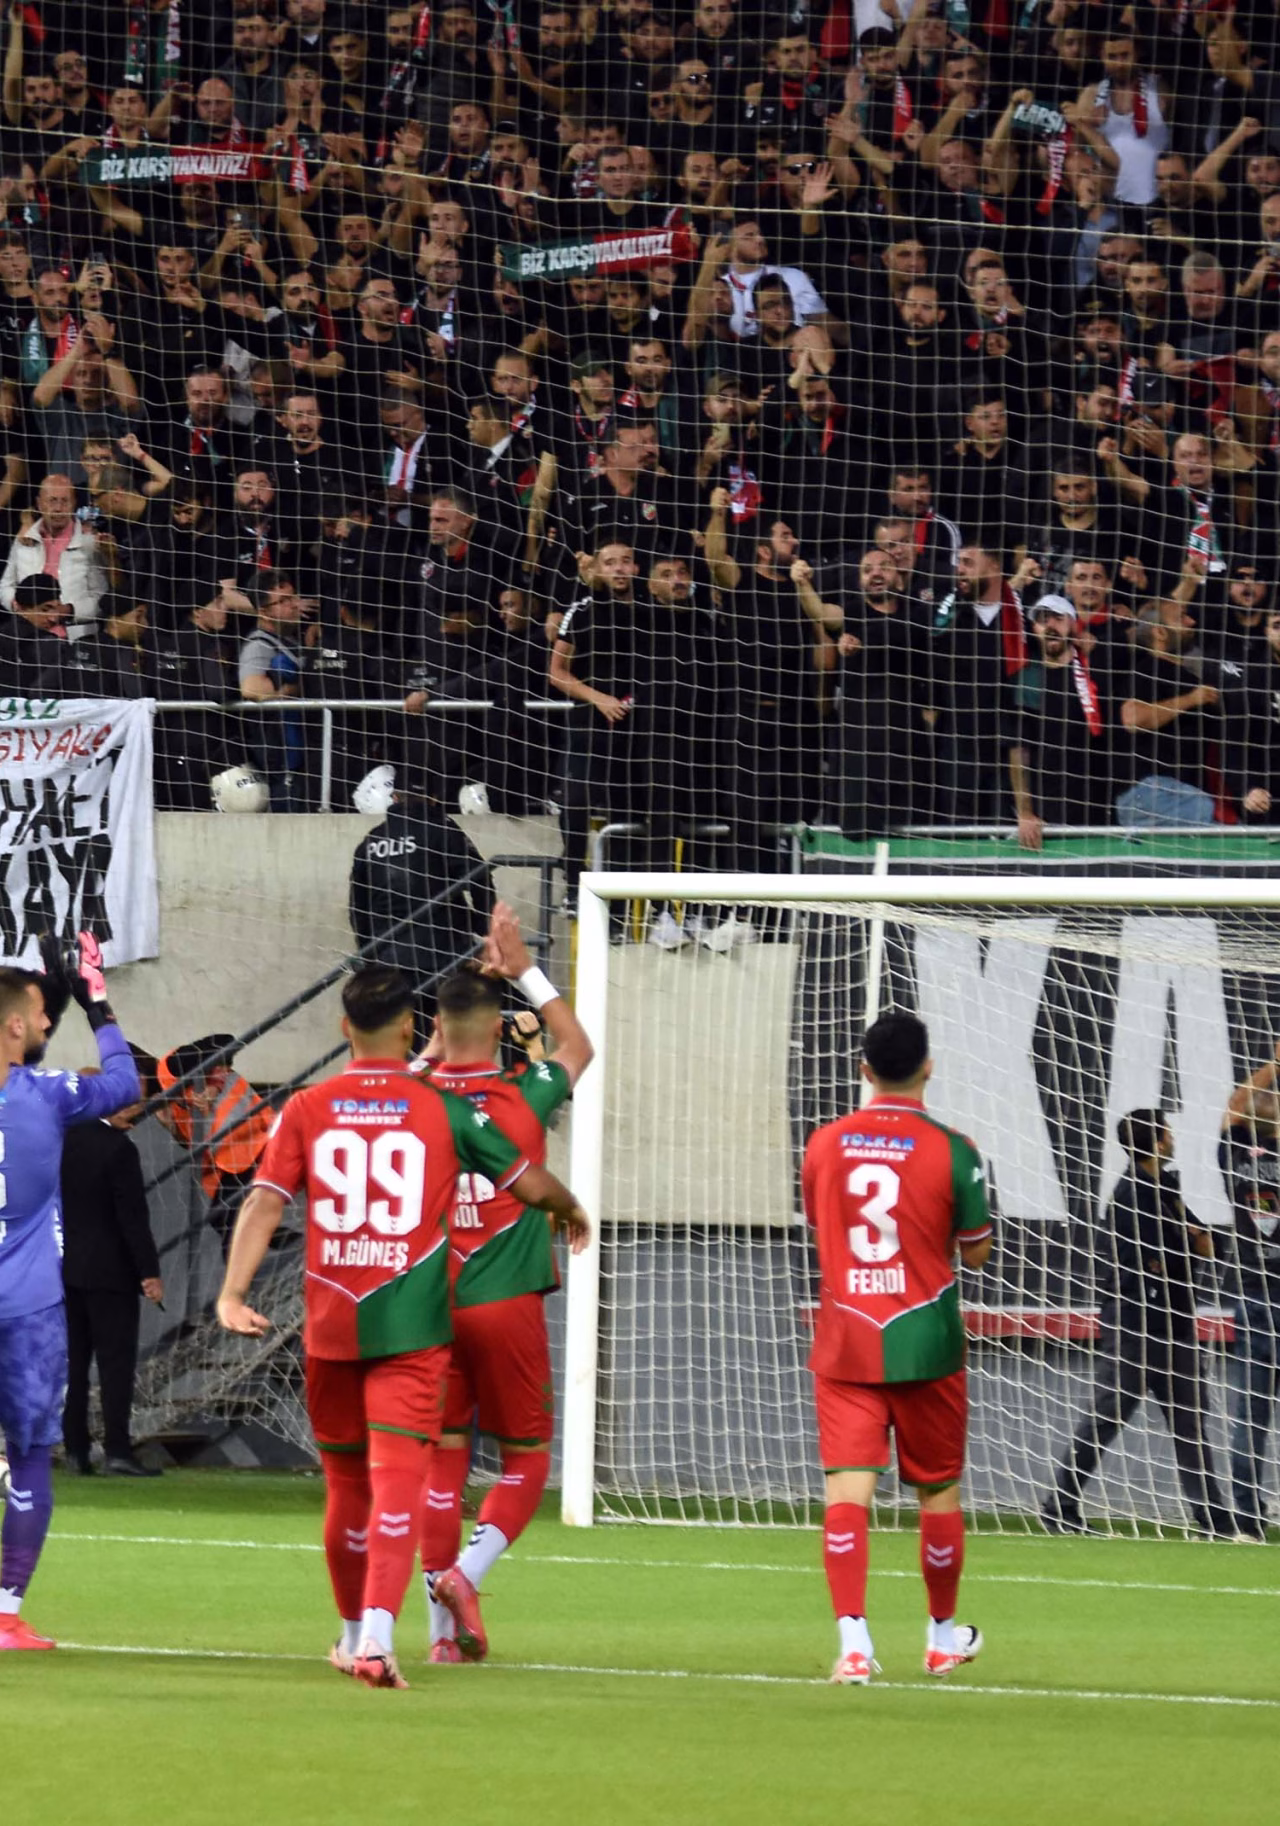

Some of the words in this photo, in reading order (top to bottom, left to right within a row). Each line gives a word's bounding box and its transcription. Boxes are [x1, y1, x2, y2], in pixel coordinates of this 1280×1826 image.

[100, 154, 124, 180] BİZ
[521, 249, 546, 276] BİZ
[332, 1099, 410, 1113] TOLKAR
[840, 1134, 915, 1151] TOLKAR
[314, 1129, 426, 1236] 99
[848, 1163, 901, 1262] 3
[322, 1234, 410, 1271] M.GÜNEŞ
[847, 1262, 906, 1294] FERDİ
